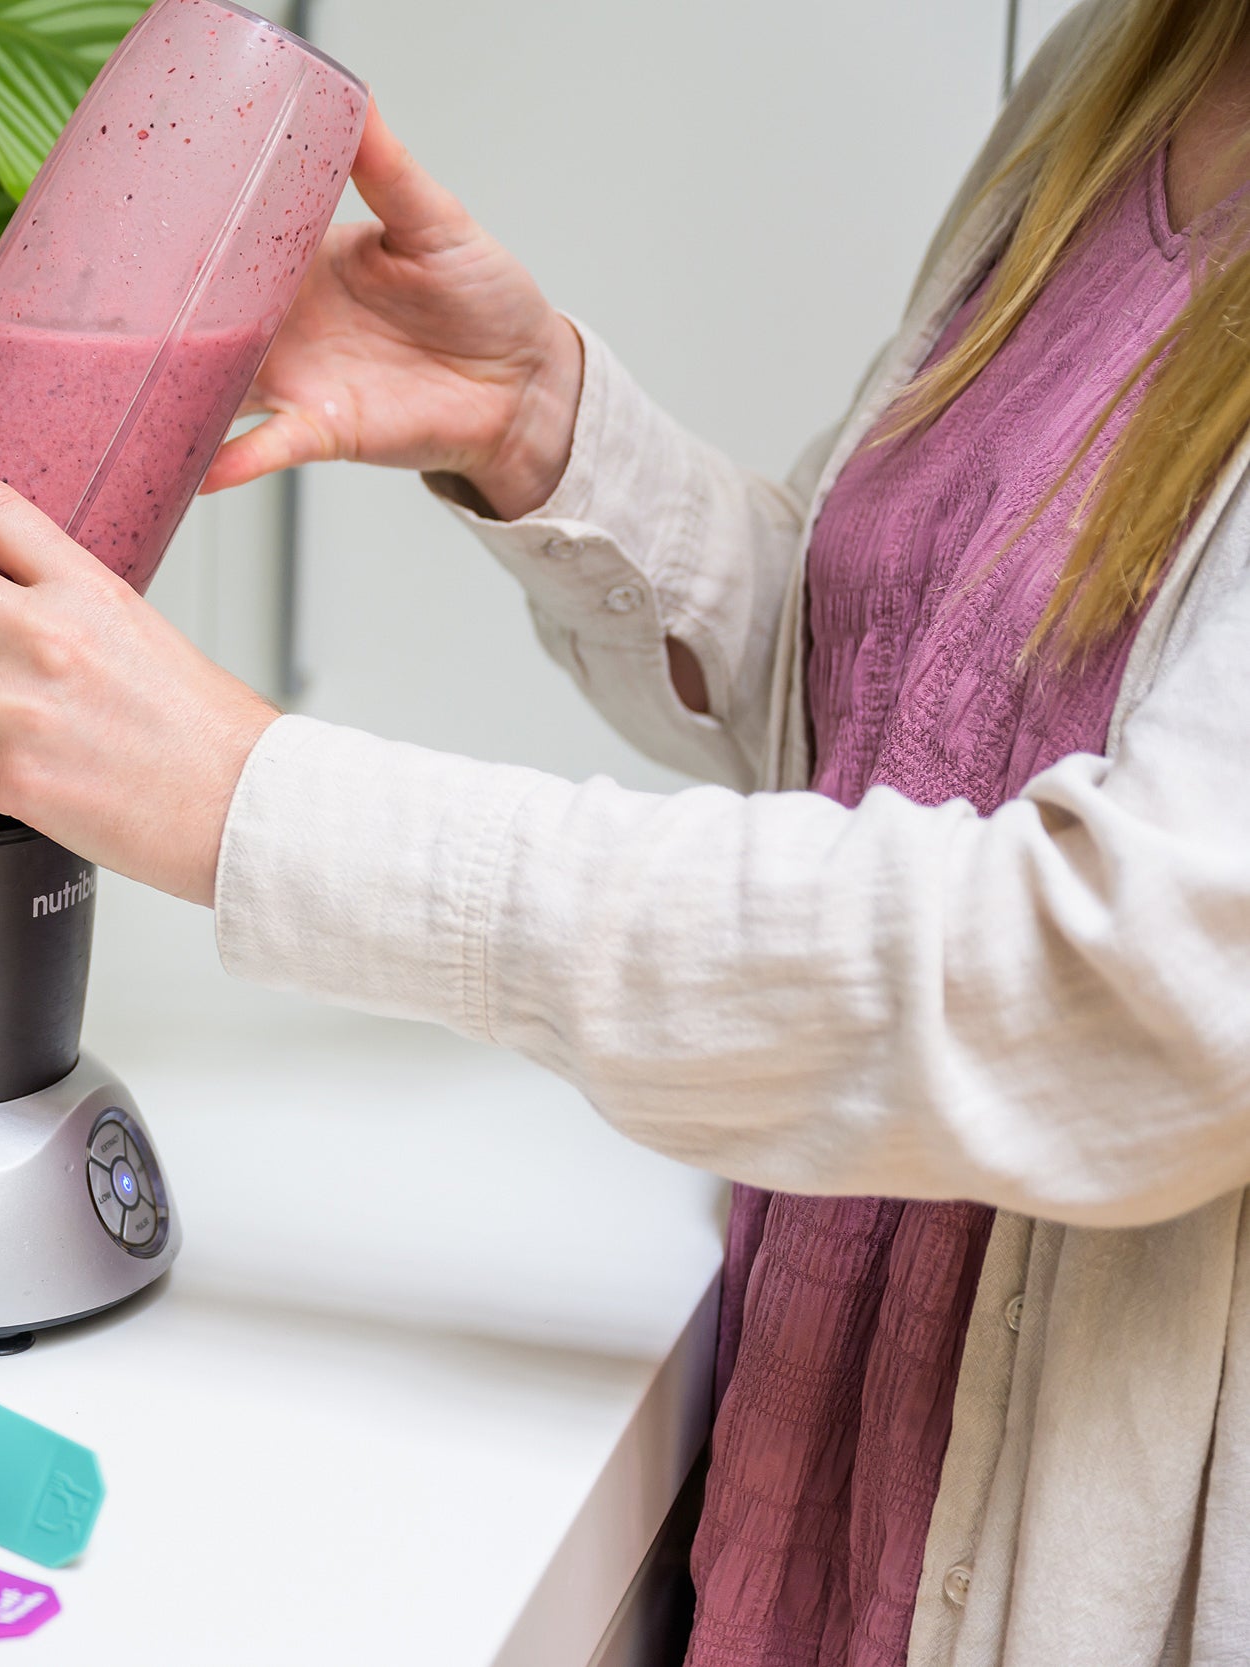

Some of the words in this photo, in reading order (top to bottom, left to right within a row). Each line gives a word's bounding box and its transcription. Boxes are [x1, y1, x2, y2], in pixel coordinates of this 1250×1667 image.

[101, 1135, 120, 1153] EXTRACT
[98, 1191, 112, 1205] LOW
[135, 1217, 150, 1232] PULSE
